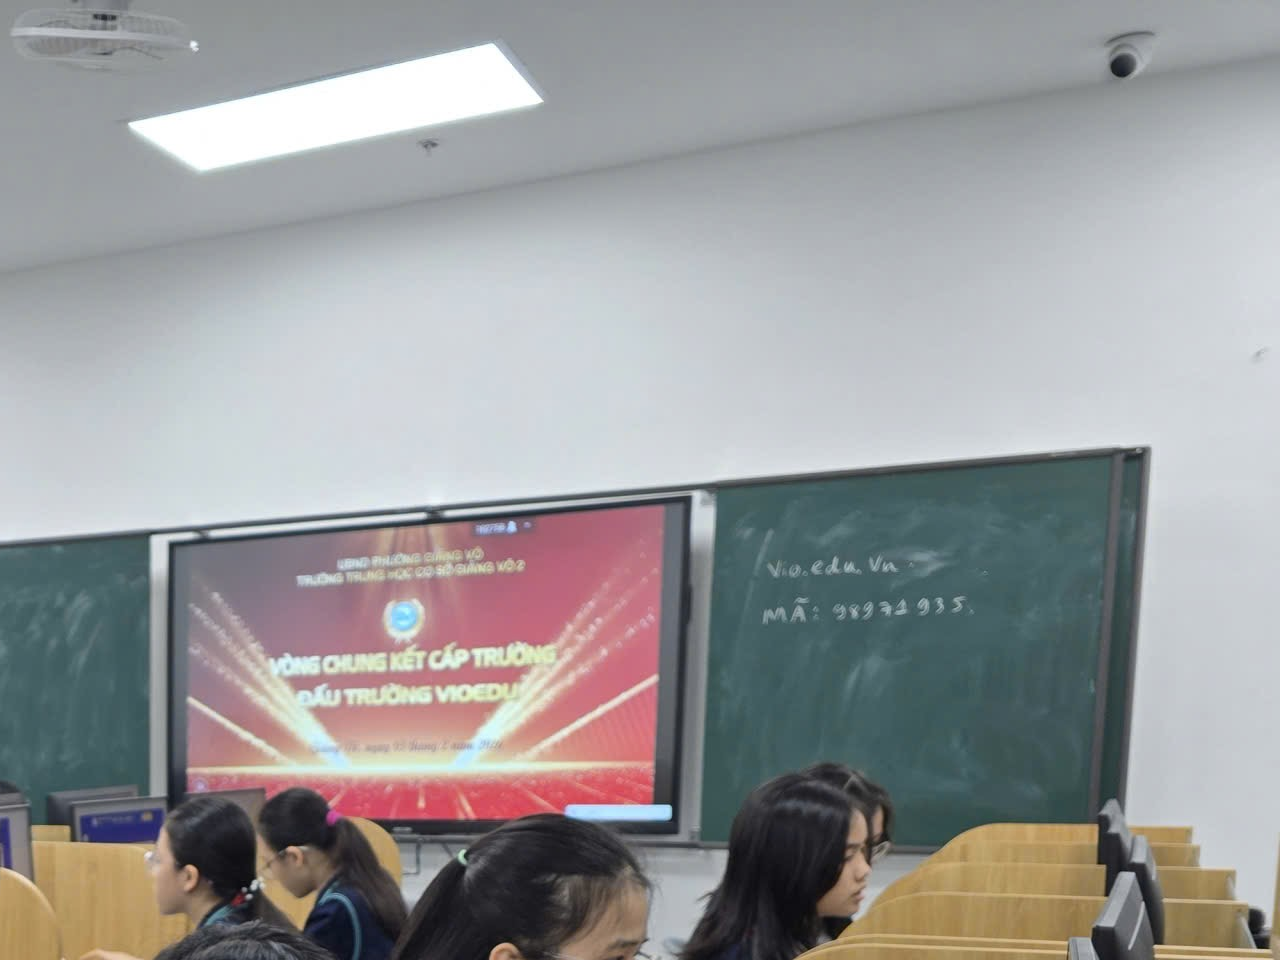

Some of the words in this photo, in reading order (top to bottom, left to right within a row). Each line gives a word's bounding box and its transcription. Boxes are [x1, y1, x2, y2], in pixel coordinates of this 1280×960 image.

[269, 652, 320, 677] VÒNG
[322, 652, 387, 674] CHUNG
[390, 644, 427, 672] KẾT
[428, 642, 471, 671] CẤP
[472, 641, 557, 667] TRƯỜNG
[343, 682, 433, 706] TRƯỜNG
[435, 682, 522, 704] VIOEDU
